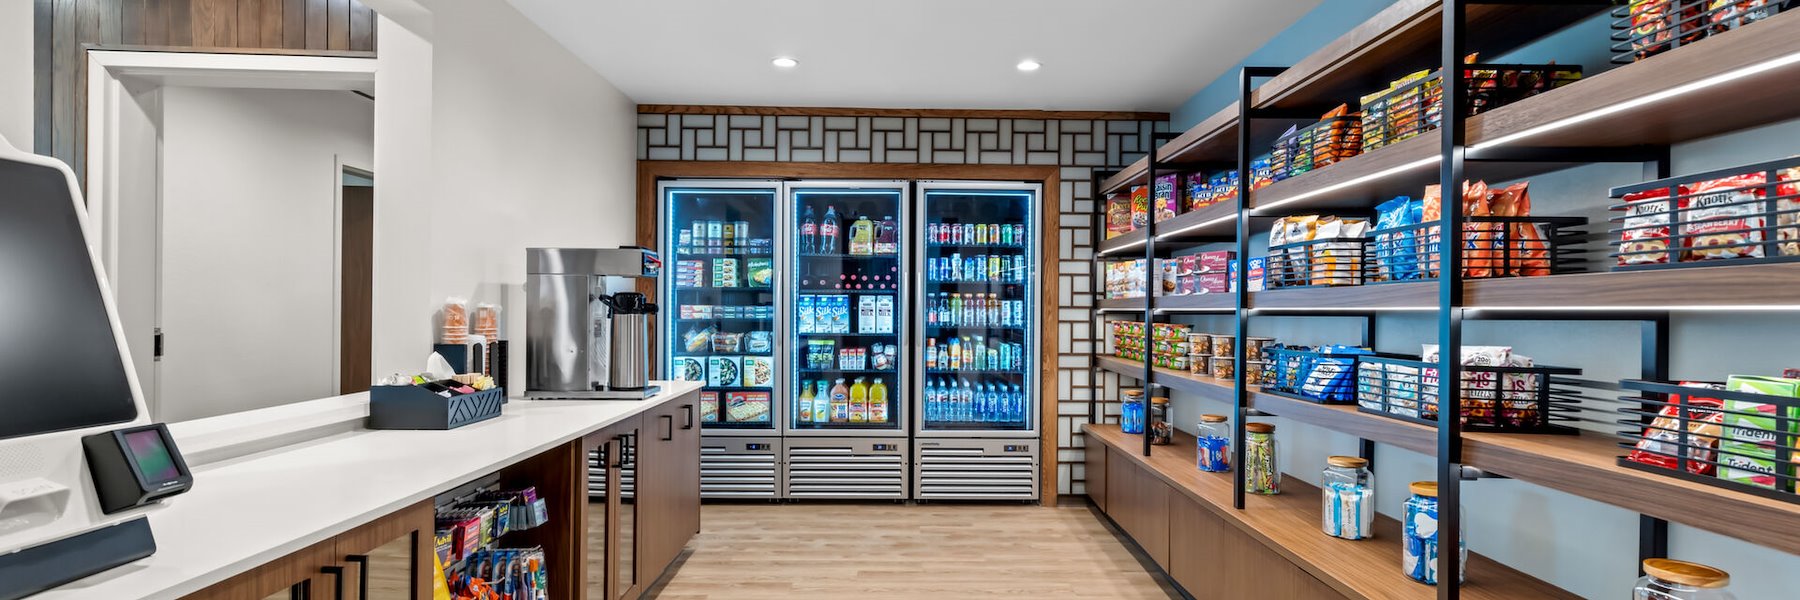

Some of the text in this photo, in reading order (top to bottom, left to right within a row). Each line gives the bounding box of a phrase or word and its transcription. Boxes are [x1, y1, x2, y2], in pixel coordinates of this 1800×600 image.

[1696, 194, 1733, 208] Knott's
[799, 306, 814, 315] Silk
[816, 306, 831, 316] Silk
[832, 306, 847, 316] Silk
